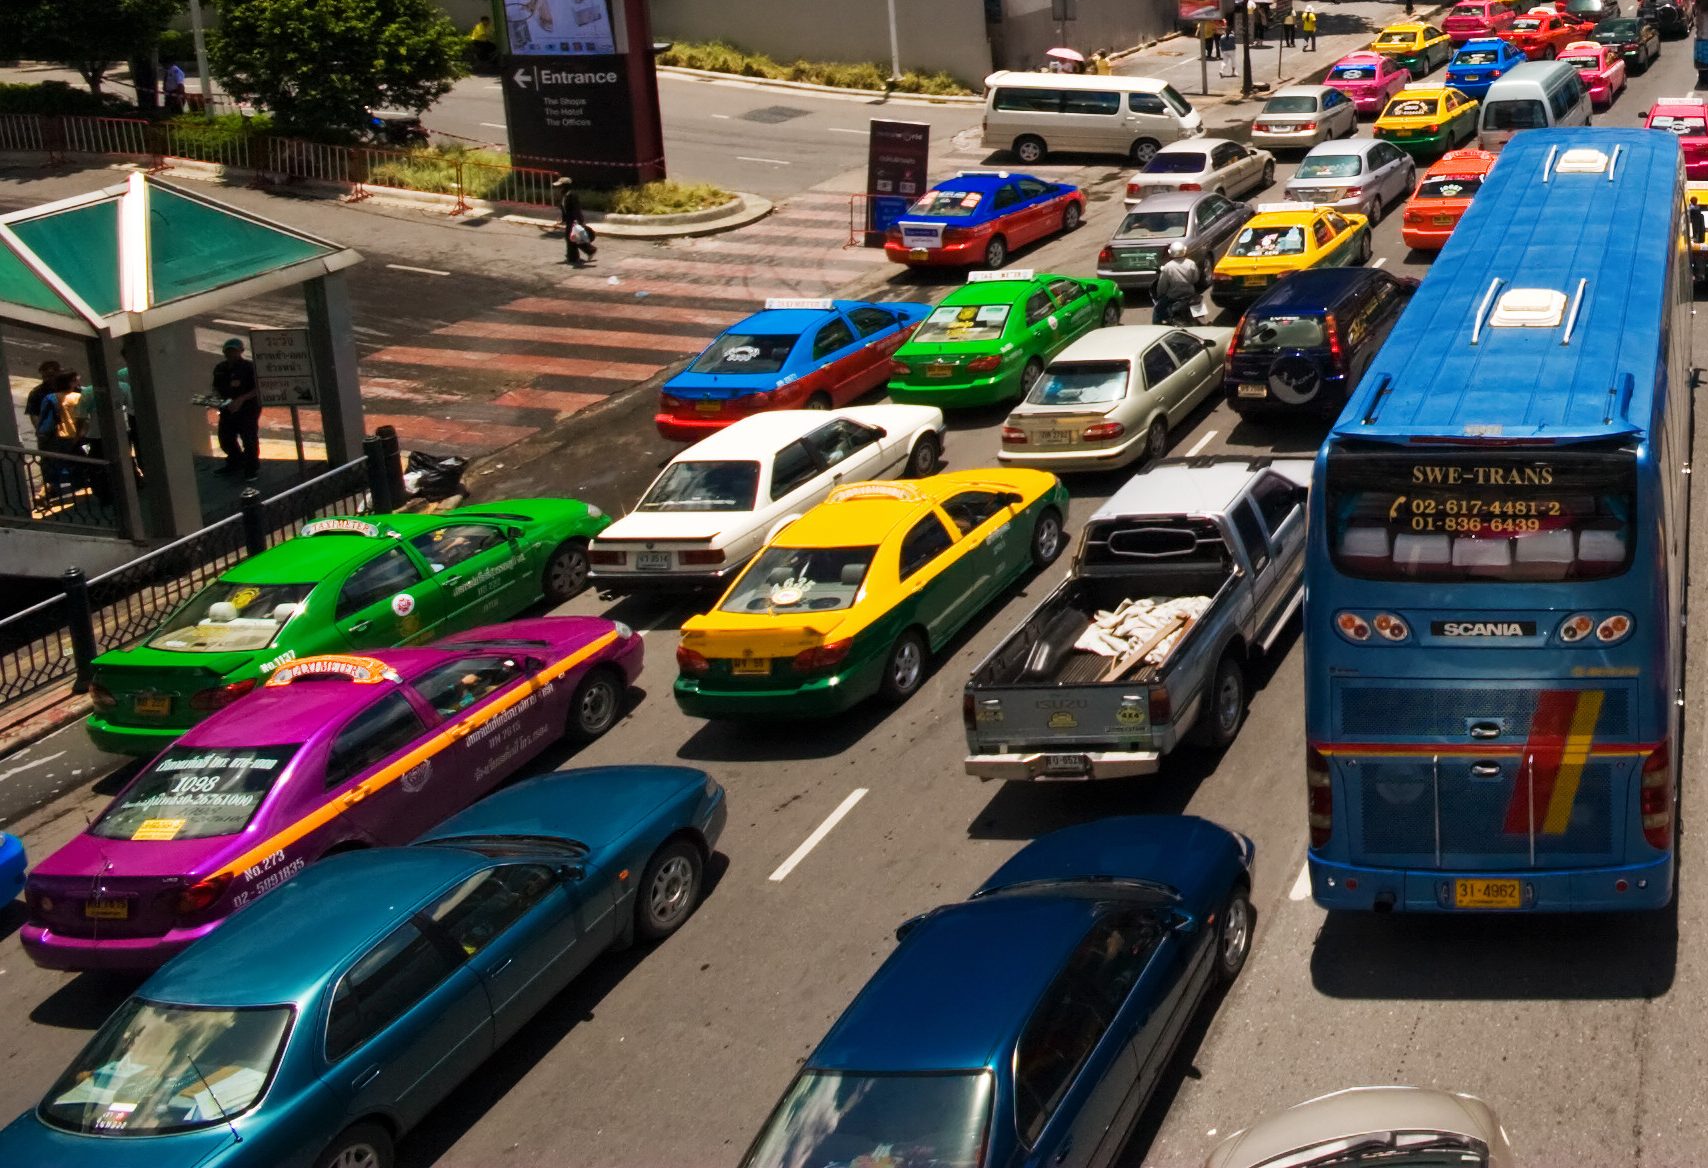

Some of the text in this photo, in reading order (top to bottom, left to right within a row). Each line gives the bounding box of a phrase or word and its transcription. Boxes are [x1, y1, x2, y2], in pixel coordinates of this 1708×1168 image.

[541, 70, 617, 84] Entrance
[545, 97, 558, 105] The
[547, 118, 560, 126] The
[1412, 466, 1553, 485] SWE-TRANS
[1411, 499, 1561, 516] 02-617-4481-2
[1411, 517, 1540, 532] 01-836-6439
[1443, 623, 1524, 637] SCANIA
[1035, 699, 1088, 710] ISUZU
[171, 776, 220, 792] 1098
[243, 849, 285, 881] No.273
[1459, 883, 1517, 898] 31-4962
